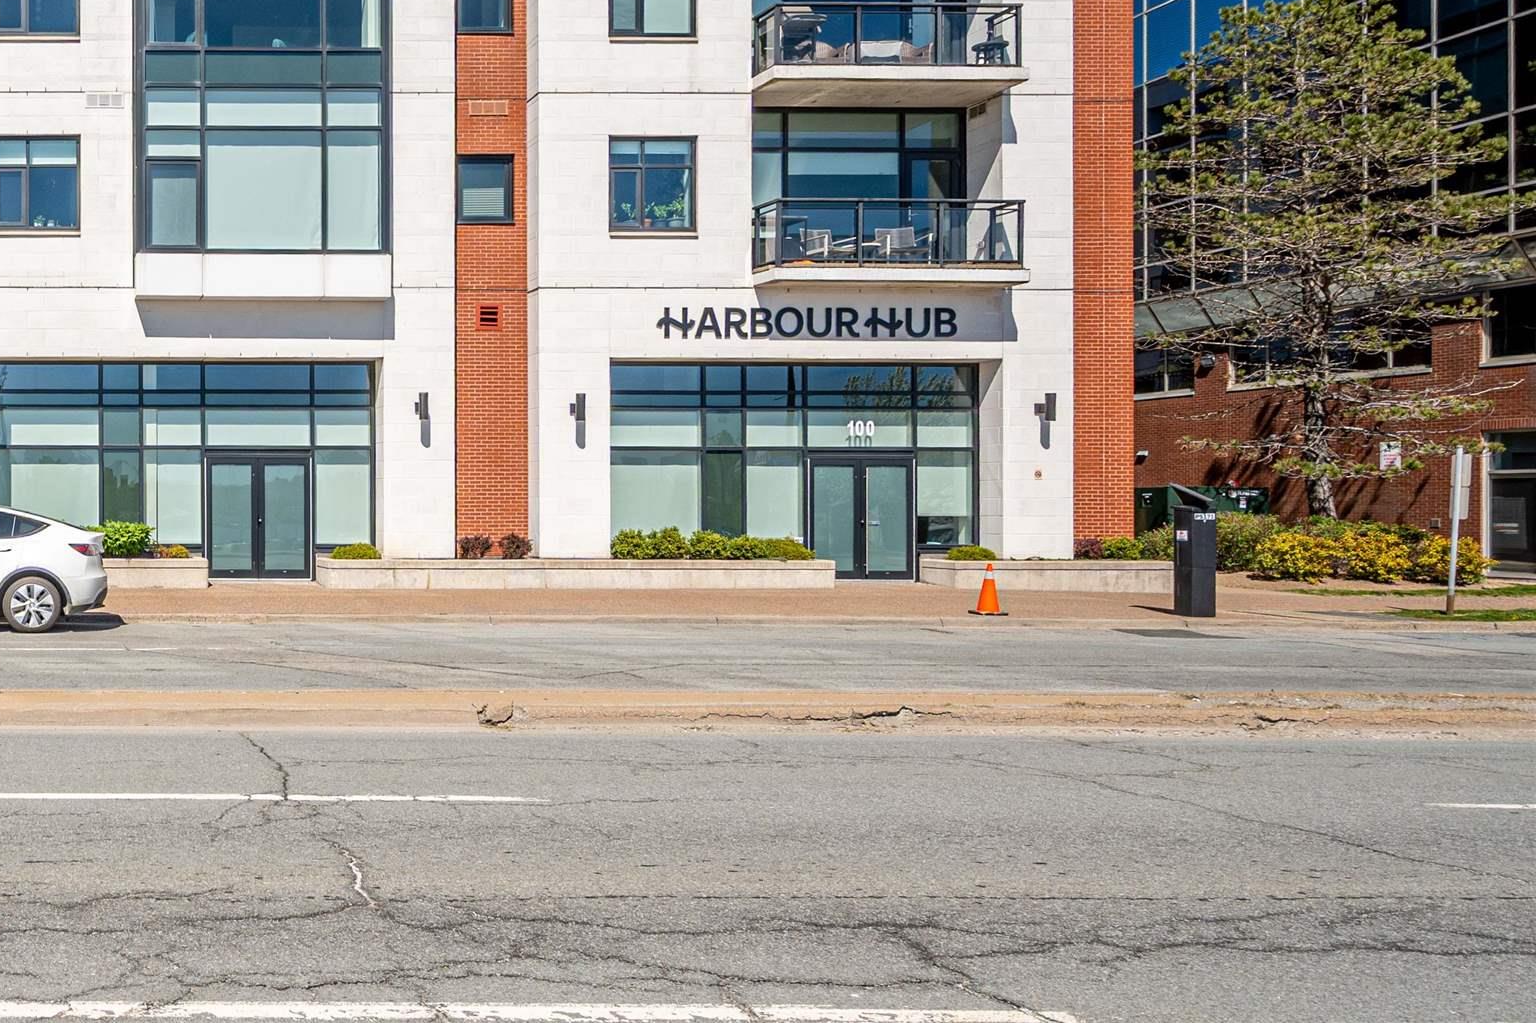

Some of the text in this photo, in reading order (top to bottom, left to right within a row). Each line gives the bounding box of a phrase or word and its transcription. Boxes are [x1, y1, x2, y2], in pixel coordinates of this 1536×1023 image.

[656, 306, 958, 339] HARBOUR HUB
[847, 420, 874, 436] 100
